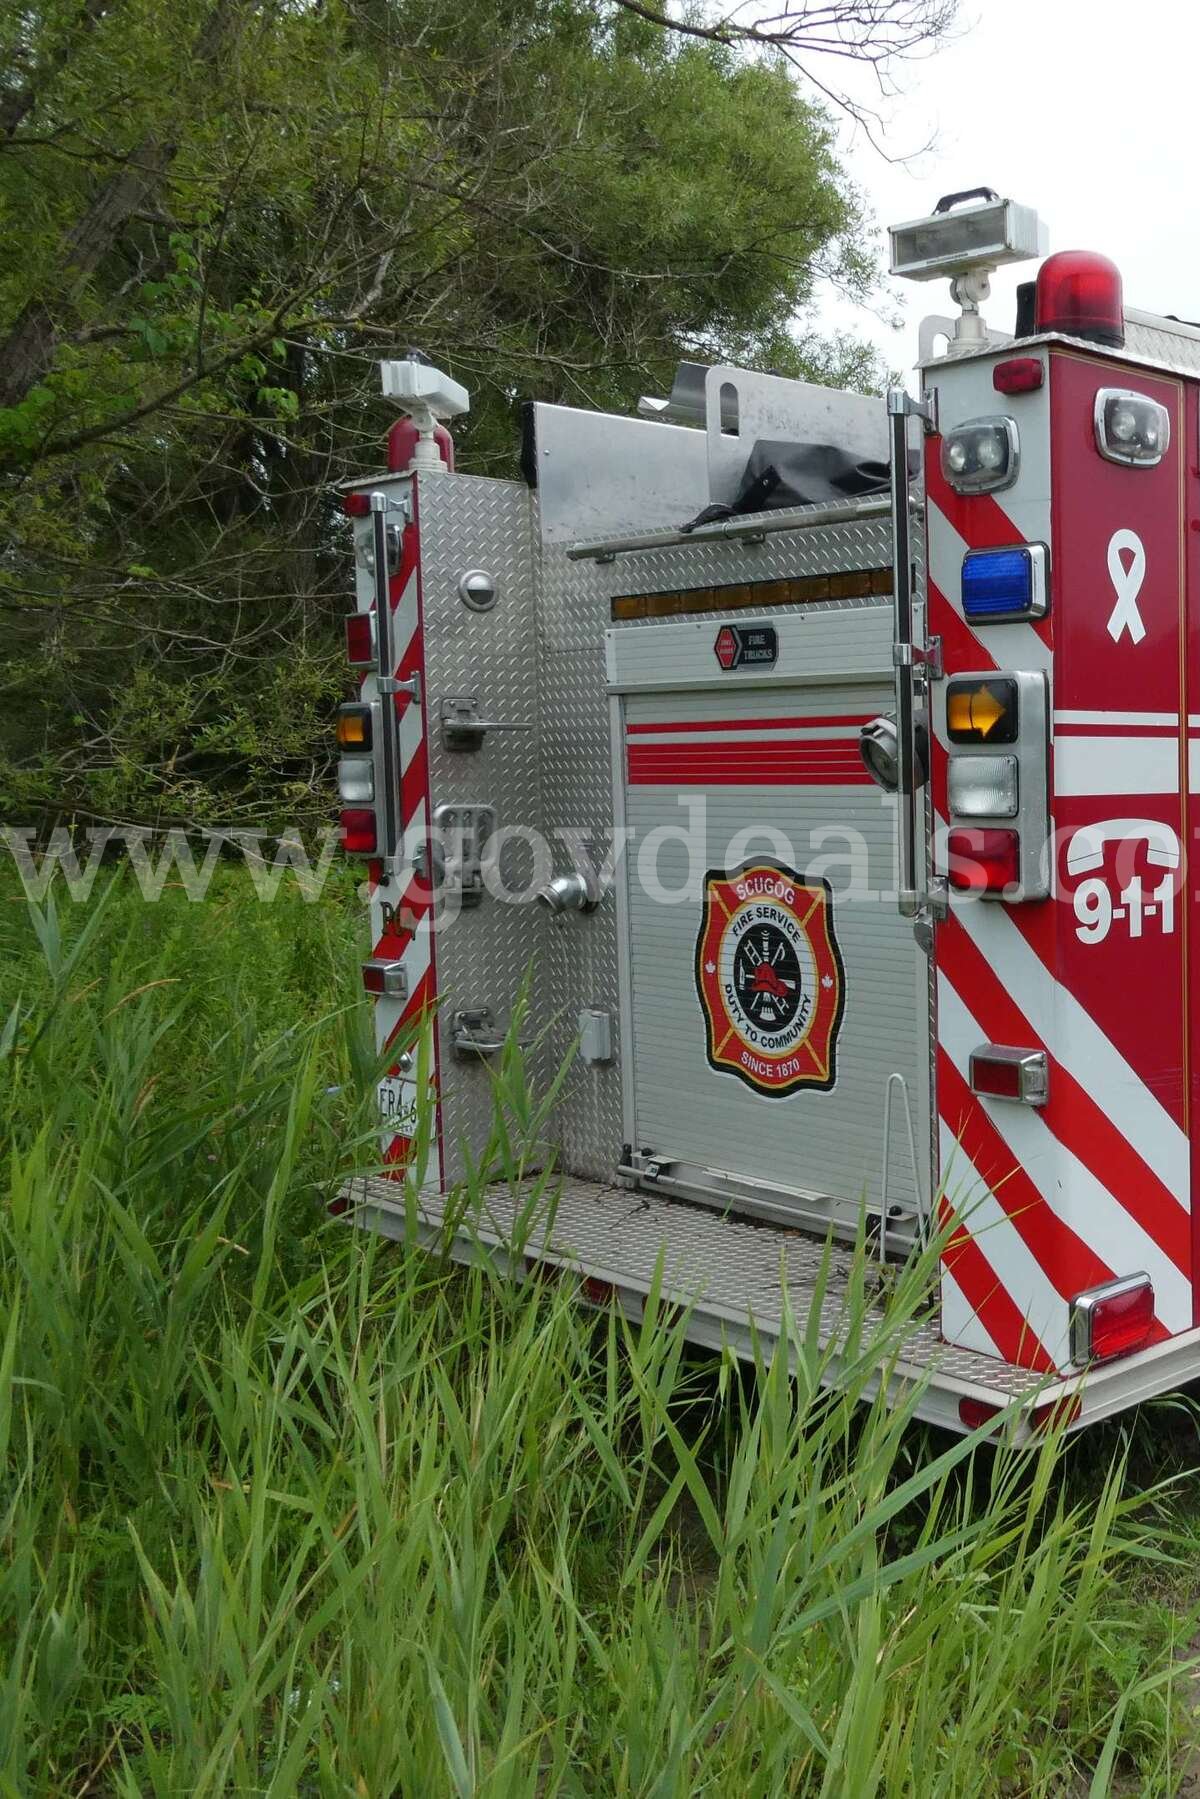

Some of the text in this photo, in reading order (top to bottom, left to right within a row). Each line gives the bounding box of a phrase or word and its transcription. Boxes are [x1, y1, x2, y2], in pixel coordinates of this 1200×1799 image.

[736, 877, 796, 905] SCUGOG
[732, 906, 801, 944] FIRE SERVICE
[725, 984, 812, 1049] DUTY TO COMMUNITY
[741, 1051, 800, 1078] SINCE 1870
